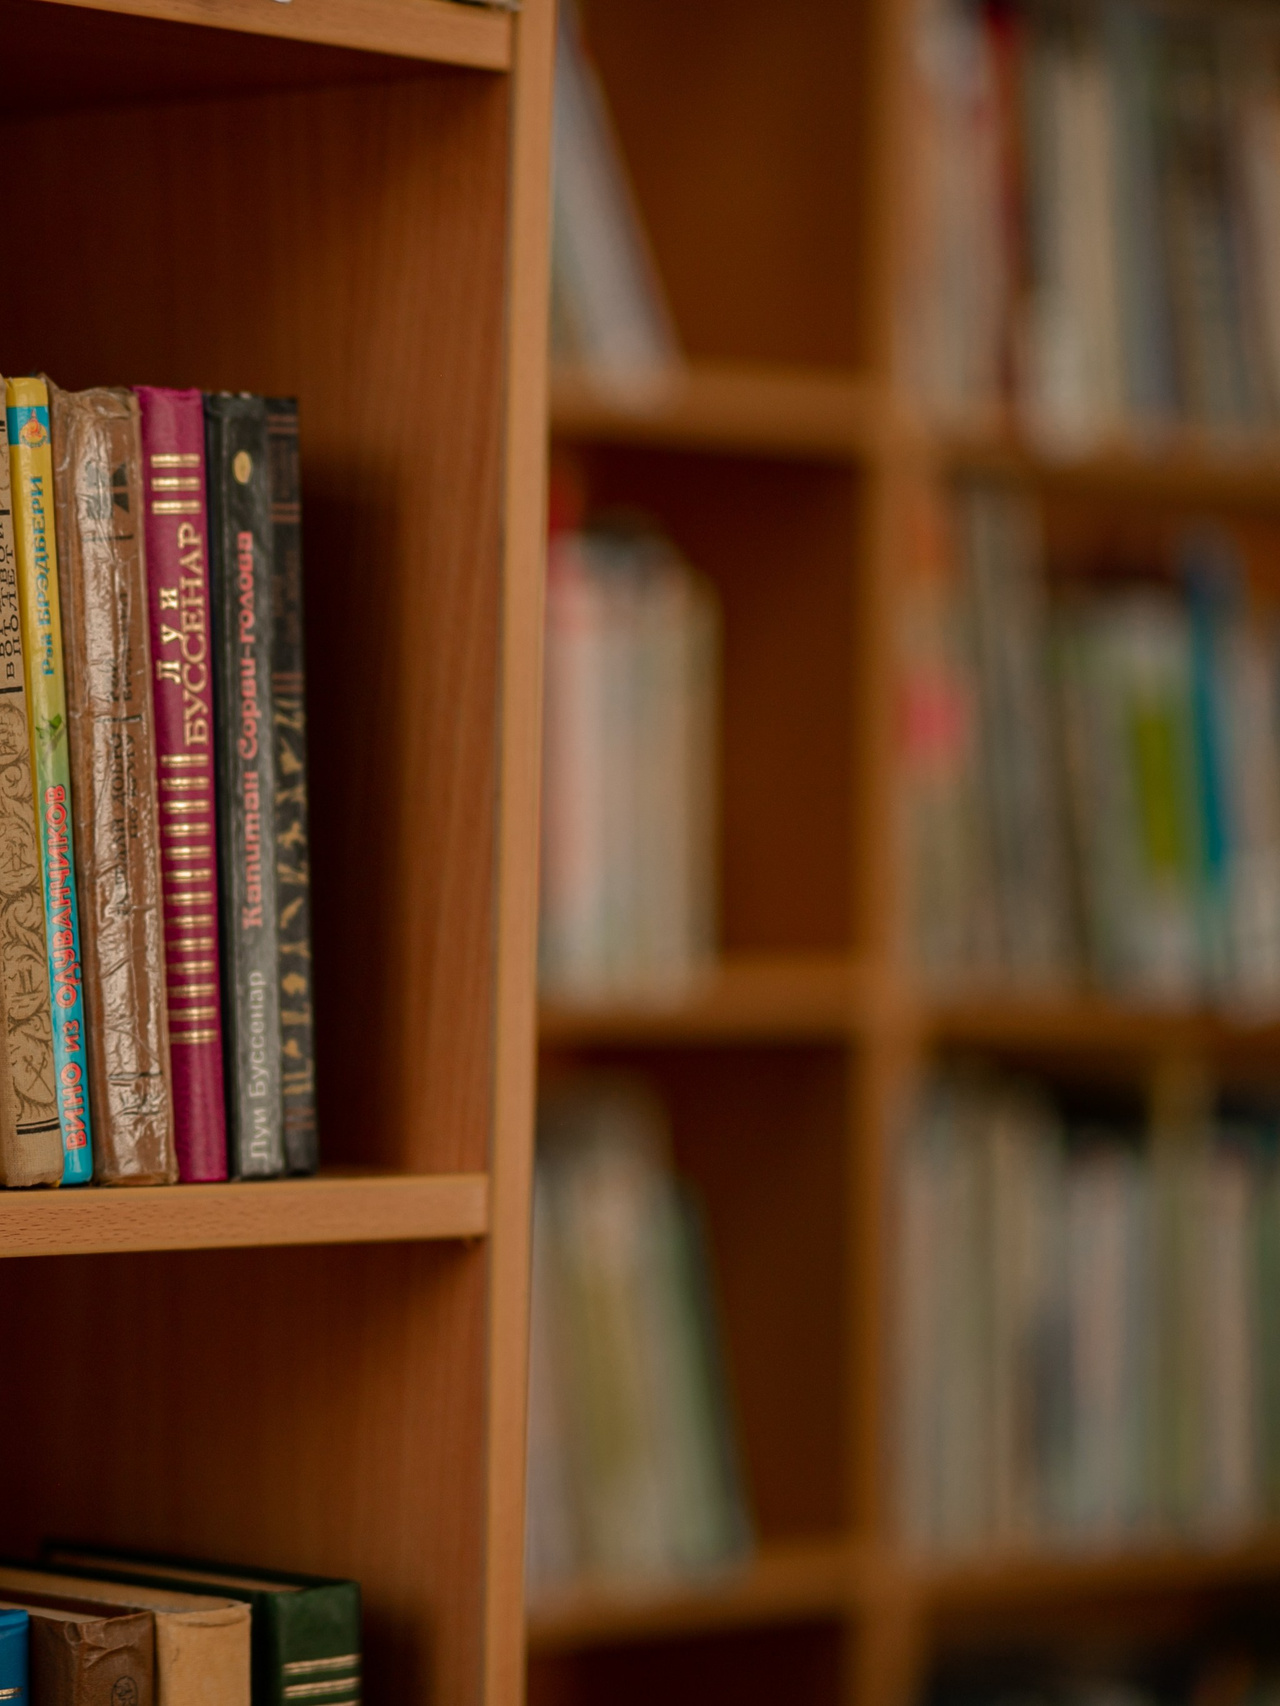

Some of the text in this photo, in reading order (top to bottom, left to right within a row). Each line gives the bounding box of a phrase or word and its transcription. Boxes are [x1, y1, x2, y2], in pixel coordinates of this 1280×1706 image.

[1, 618, 17, 680] ВОТ
[5, 545, 22, 656] ПОЛЕТ
[29, 475, 55, 676] Рэй БРЭДБЕРИ
[155, 586, 185, 686] Луи
[176, 520, 210, 747] БУССЕНАР
[237, 530, 270, 1160] Луи Буссенар Капитан Сорви-голова
[44, 783, 88, 1152] ВИНО из ОДУВАНЧИКОВ
